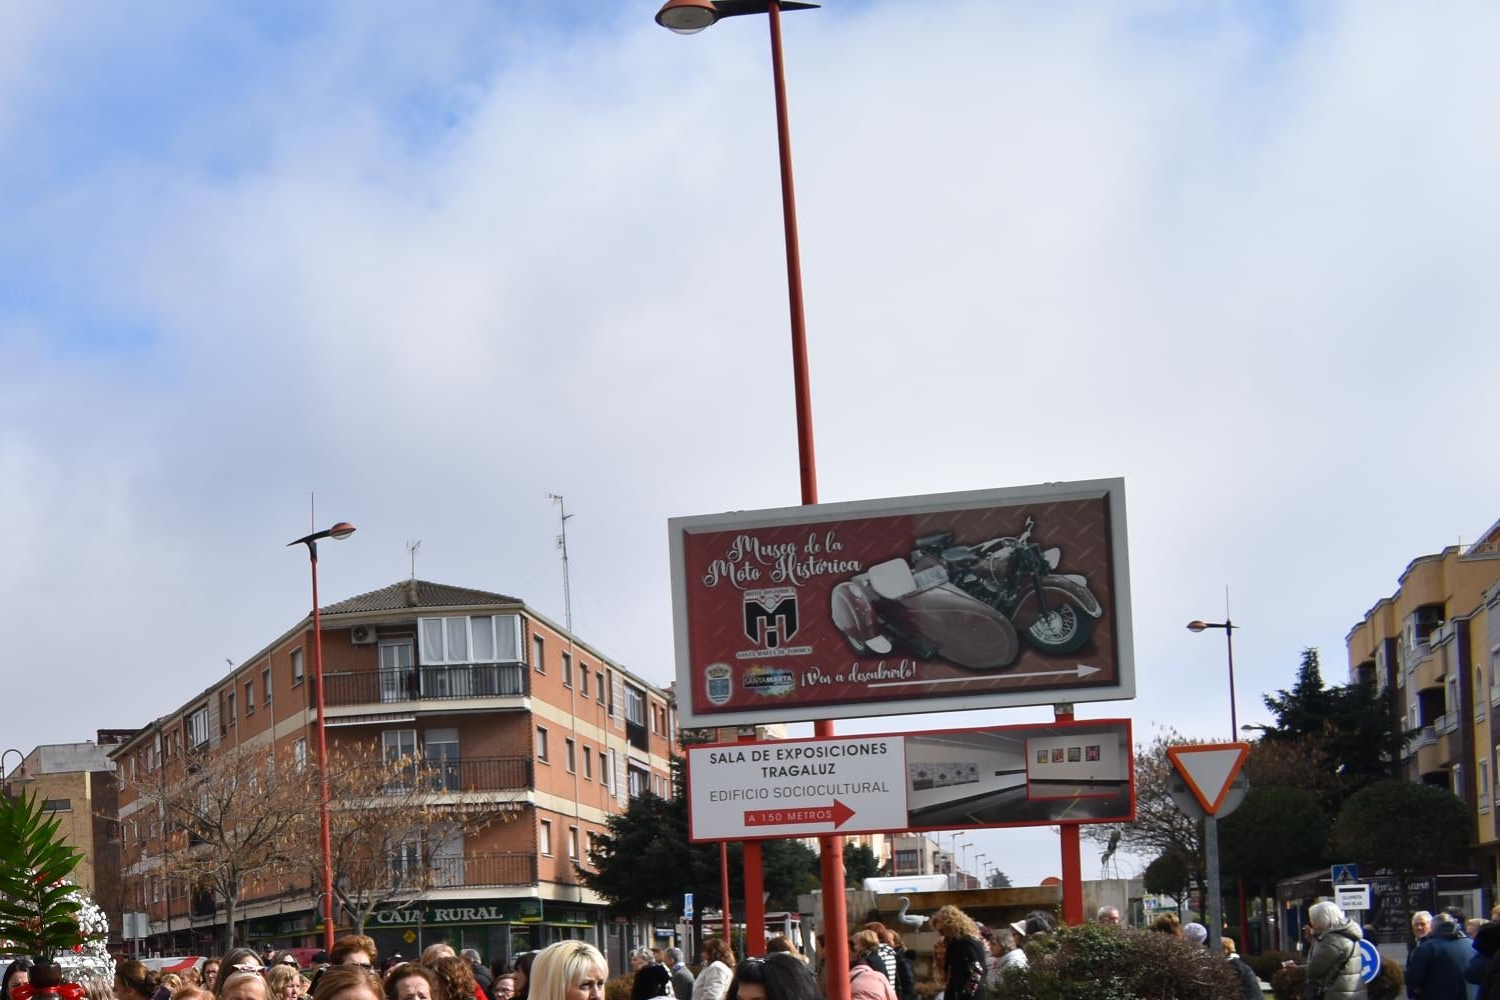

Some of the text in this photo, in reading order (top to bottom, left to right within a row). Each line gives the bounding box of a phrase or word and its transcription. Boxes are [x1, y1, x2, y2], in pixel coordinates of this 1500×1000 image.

[726, 530, 844, 566] Museo de la
[702, 553, 863, 590] Moto Histórica
[835, 674, 844, 682] a
[709, 742, 888, 765] SALA DE EXPOSICIONES
[761, 763, 836, 779] TRAGALUZ
[709, 781, 890, 802] EDIFICIO SOCIOCULTURAL
[748, 809, 832, 823] A 150 METROS
[377, 906, 504, 924] CAJA RURAL
